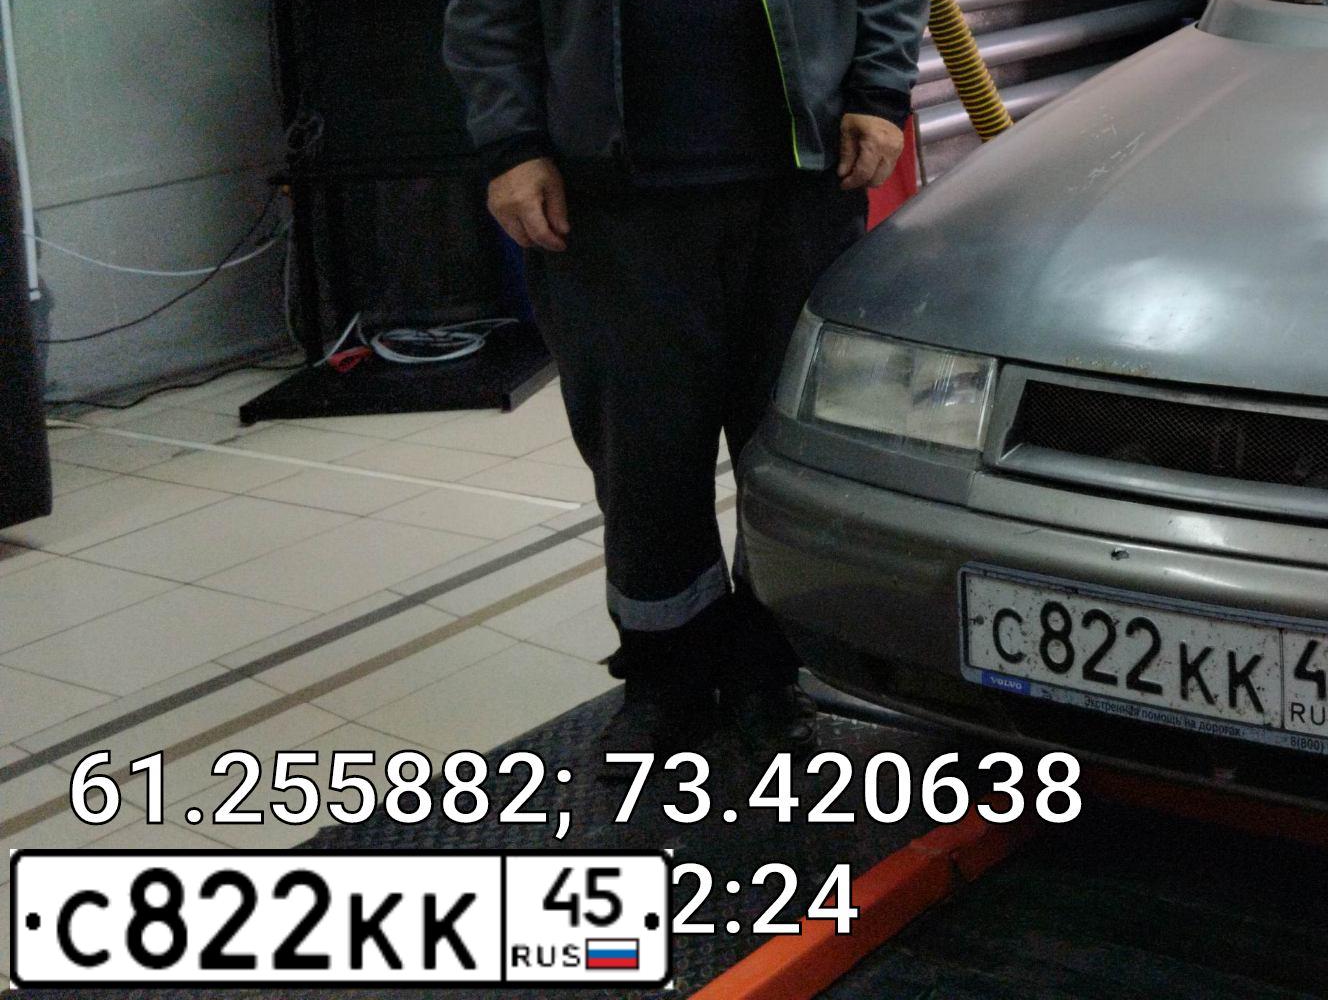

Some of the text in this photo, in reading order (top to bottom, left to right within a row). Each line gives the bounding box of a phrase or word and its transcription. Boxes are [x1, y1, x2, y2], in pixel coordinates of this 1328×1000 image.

[989, 676, 1022, 690] VOLVO
[1141, 709, 1181, 725] помощь
[1184, 718, 1197, 729] на
